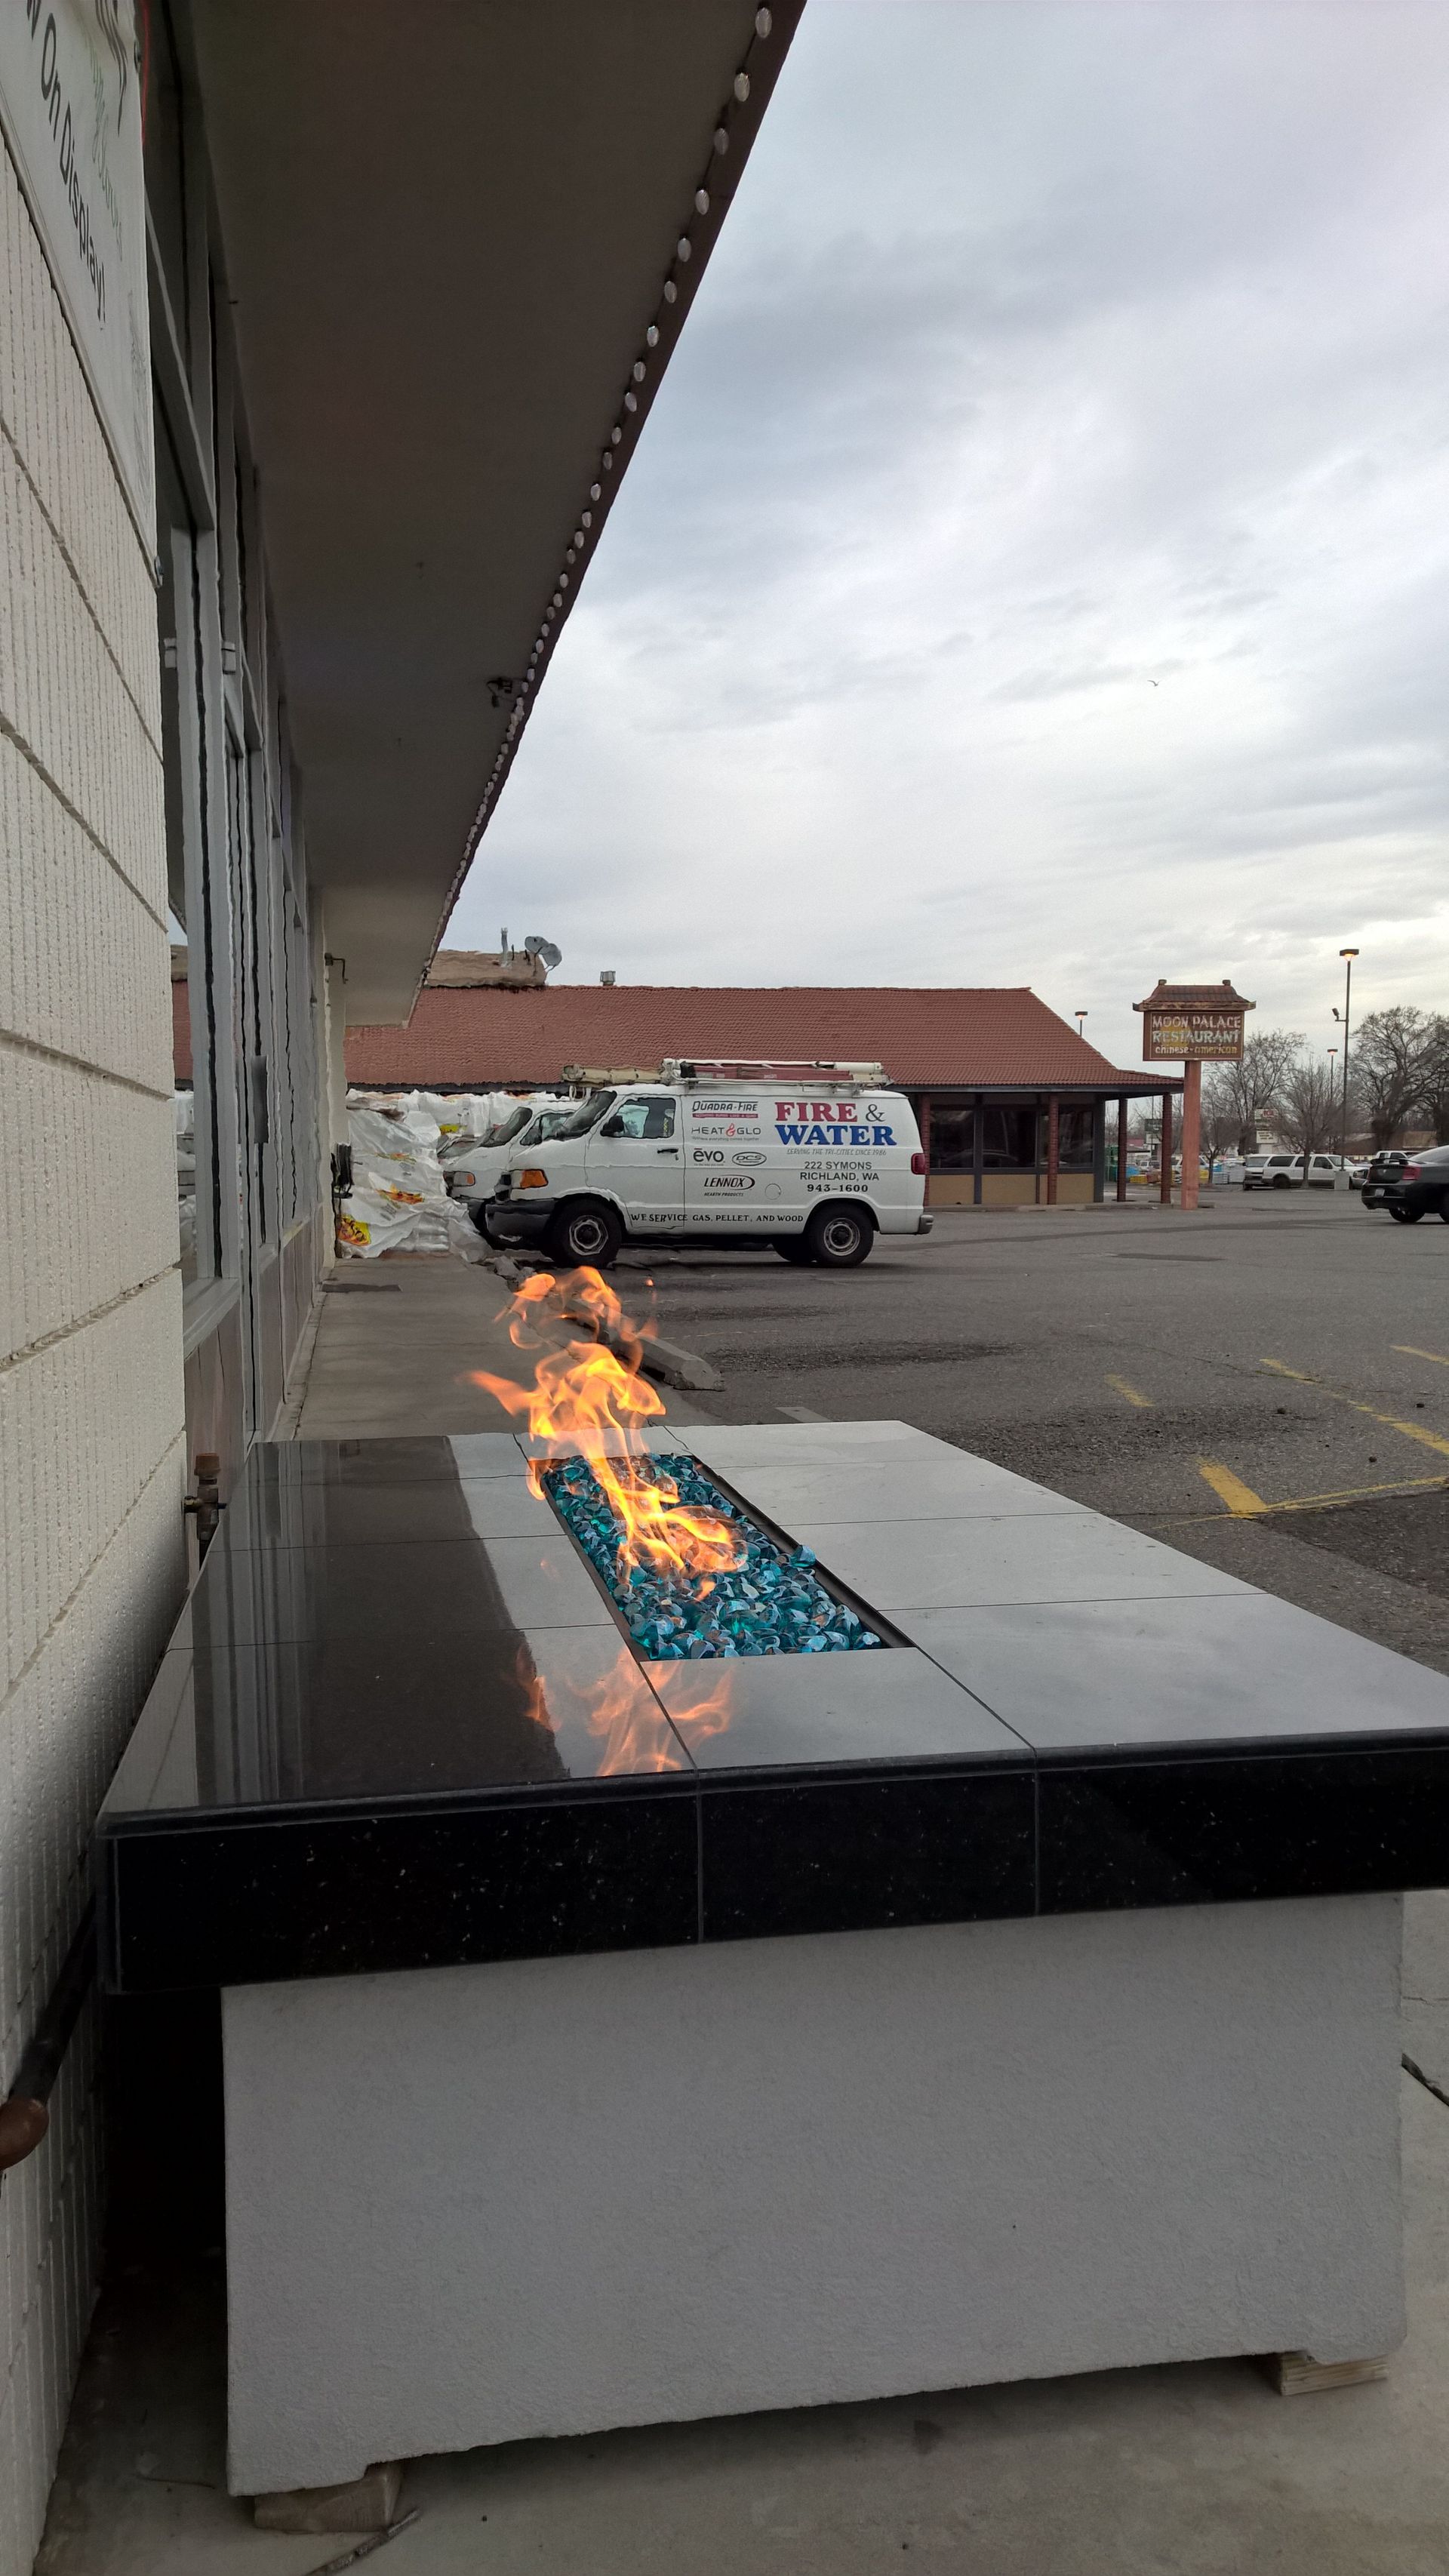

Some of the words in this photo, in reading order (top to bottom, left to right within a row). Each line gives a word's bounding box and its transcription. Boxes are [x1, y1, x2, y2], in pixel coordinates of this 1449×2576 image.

[42, 13, 61, 143] On
[1152, 1015, 1189, 1028] MOON
[1193, 1015, 1241, 1028] PALACE
[1152, 1029, 1241, 1043] RESTAURANT
[775, 1102, 858, 1122] FIRE
[866, 1103, 886, 1122] &
[774, 1125, 897, 1146] WATER
[826, 1162, 872, 1170] SYMONS
[704, 1177, 746, 1187] LENNOX
[800, 1172, 859, 1181] RICHLAND,
[648, 1214, 688, 1222] SERVICE
